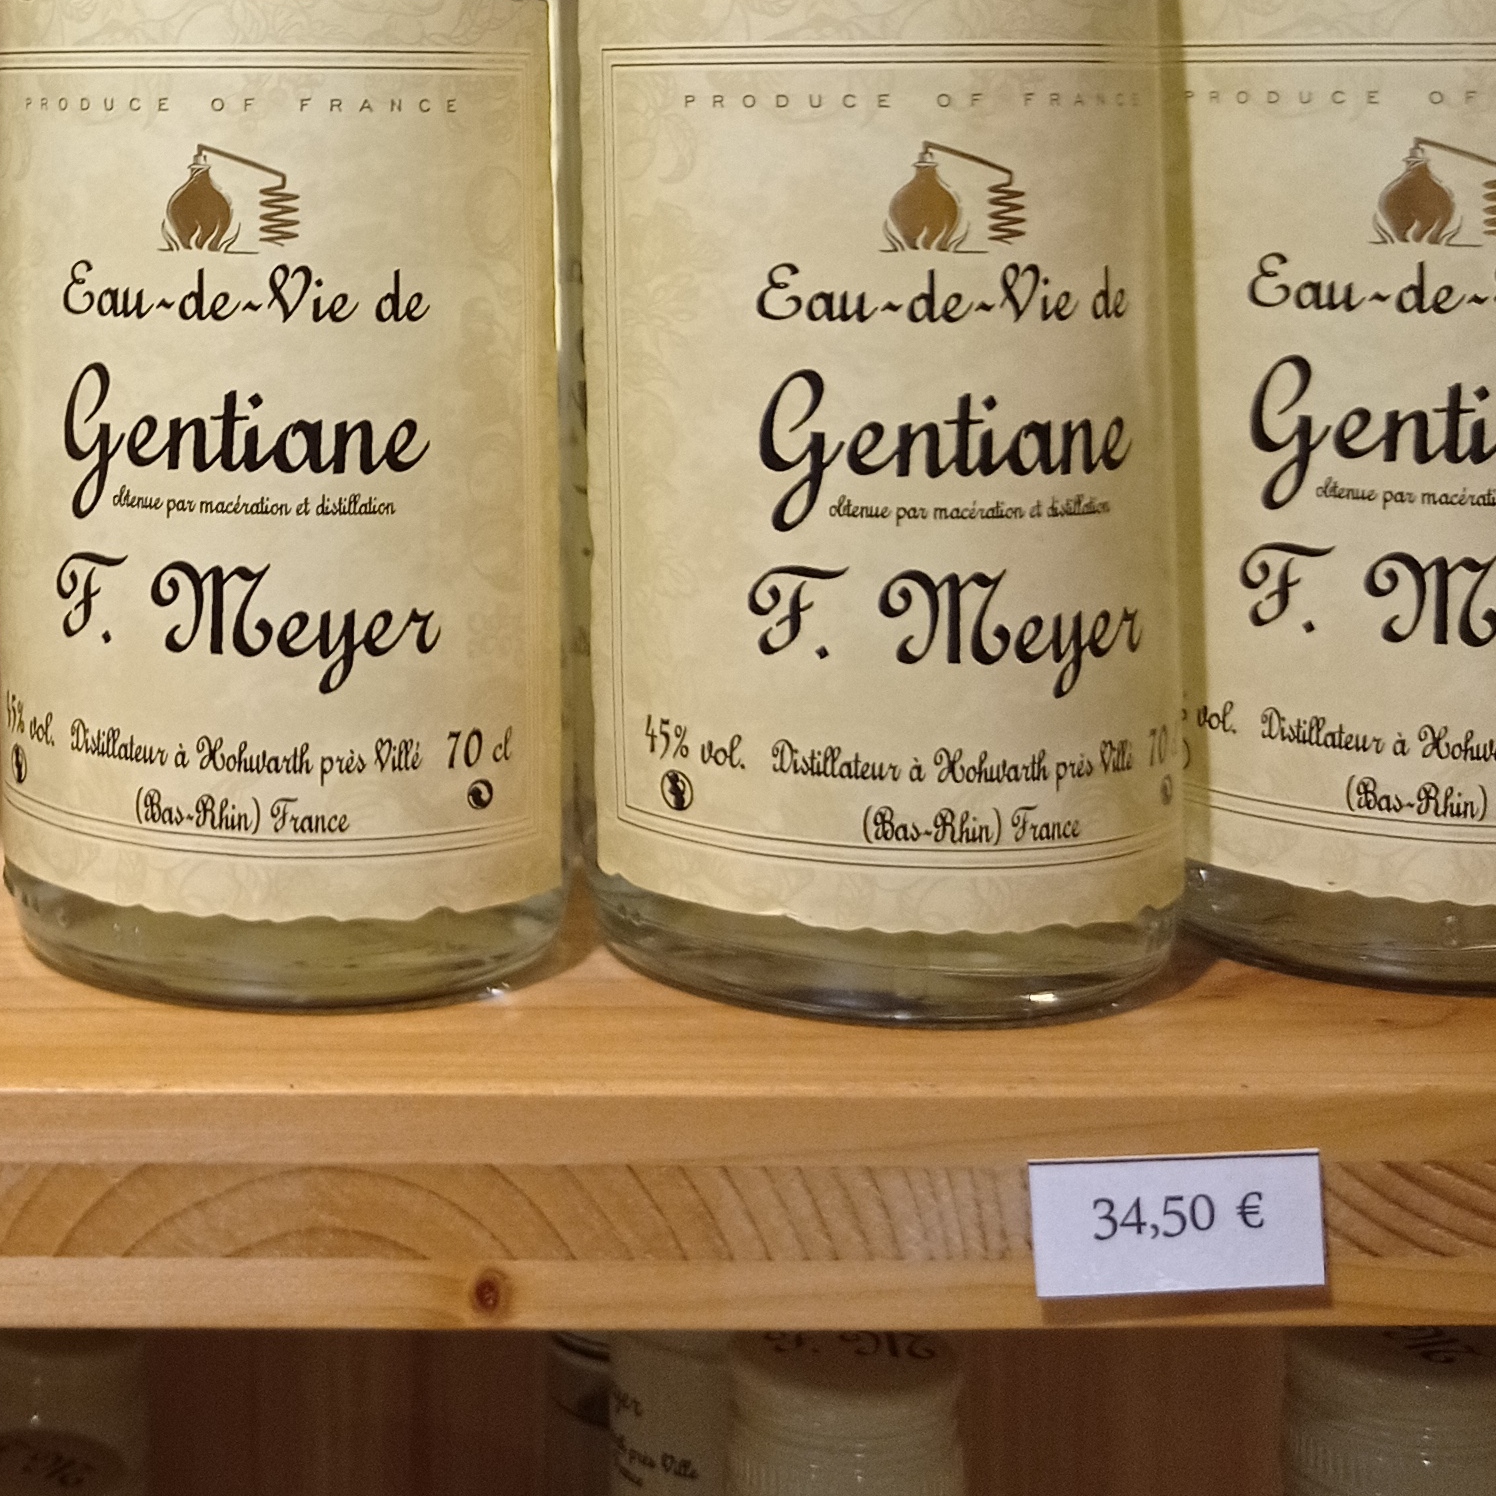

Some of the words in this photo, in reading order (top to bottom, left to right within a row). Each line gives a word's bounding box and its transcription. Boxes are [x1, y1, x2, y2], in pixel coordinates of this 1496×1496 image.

[23, 96, 170, 114] PRODUCE
[209, 96, 256, 114] OF
[298, 96, 459, 114] FRANCE
[683, 93, 892, 110] PRODUCE
[936, 93, 984, 110] OF
[1184, 90, 1380, 104] PRODUCE
[1428, 90, 1478, 104] OF
[374, 267, 431, 324] de
[1089, 265, 1129, 322] de
[1247, 252, 1496, 315] Eau-de-
[63, 361, 431, 520] Gentiane
[759, 368, 1133, 533] Gentiane
[1249, 354, 1496, 510] Genti
[166, 496, 196, 518] par
[199, 494, 292, 516] macération
[295, 495, 310, 516] et
[315, 493, 396, 516] distillation
[895, 504, 929, 527] par
[932, 499, 1025, 520] macération
[1029, 498, 1044, 519] et
[1382, 489, 1415, 510] par
[1420, 486, 1496, 507] macérati
[1239, 541, 1336, 634] F.
[56, 550, 129, 644] F.
[150, 559, 441, 695] Meyer
[747, 564, 850, 660] F.
[877, 568, 1144, 699] Meyer
[29, 711, 55, 747] vol.
[70, 718, 168, 768] Distillateur
[173, 742, 191, 768] à
[196, 734, 314, 774] Hohwarth
[319, 745, 367, 787] près
[374, 737, 423, 775] Villé
[445, 727, 484, 770] 70
[491, 725, 513, 762] cl
[643, 713, 690, 760] 45%
[699, 734, 746, 771] vol.
[771, 738, 901, 784] Distillateur
[908, 755, 926, 783] à
[933, 746, 1049, 785] Hohwarth
[1055, 752, 1094, 792] près
[1197, 700, 1237, 734] vol.
[1260, 706, 1386, 755] Distillateur
[1392, 732, 1410, 757] à
[1417, 723, 1496, 763] Hohw
[270, 795, 351, 834] France
[1009, 804, 1081, 843] France
[1092, 1193, 1216, 1241] 34,50
[1235, 1191, 1265, 1229] €
